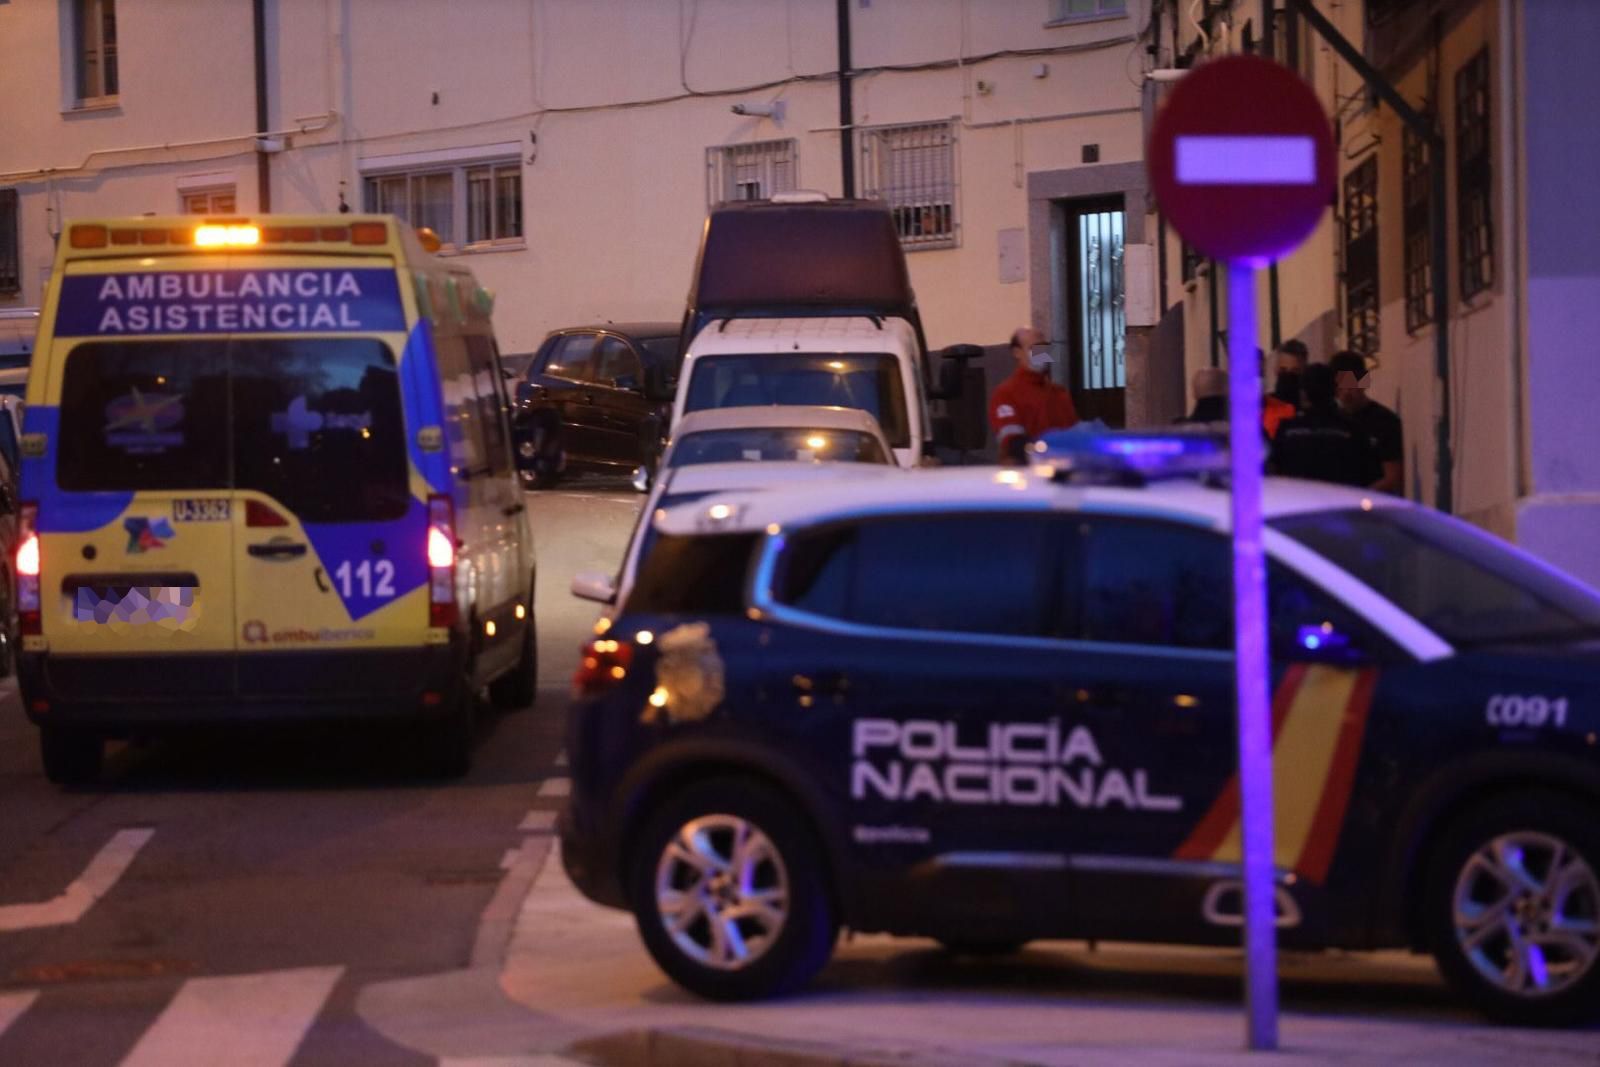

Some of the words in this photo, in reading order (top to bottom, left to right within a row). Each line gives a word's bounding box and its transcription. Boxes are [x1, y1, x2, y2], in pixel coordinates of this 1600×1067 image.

[100, 272, 361, 300] AMBULANCIA
[100, 303, 361, 331] ASISTENCIAL
[336, 560, 396, 598] 112
[853, 718, 1100, 764] POLICÍA
[853, 760, 1182, 811] NACIONAL
